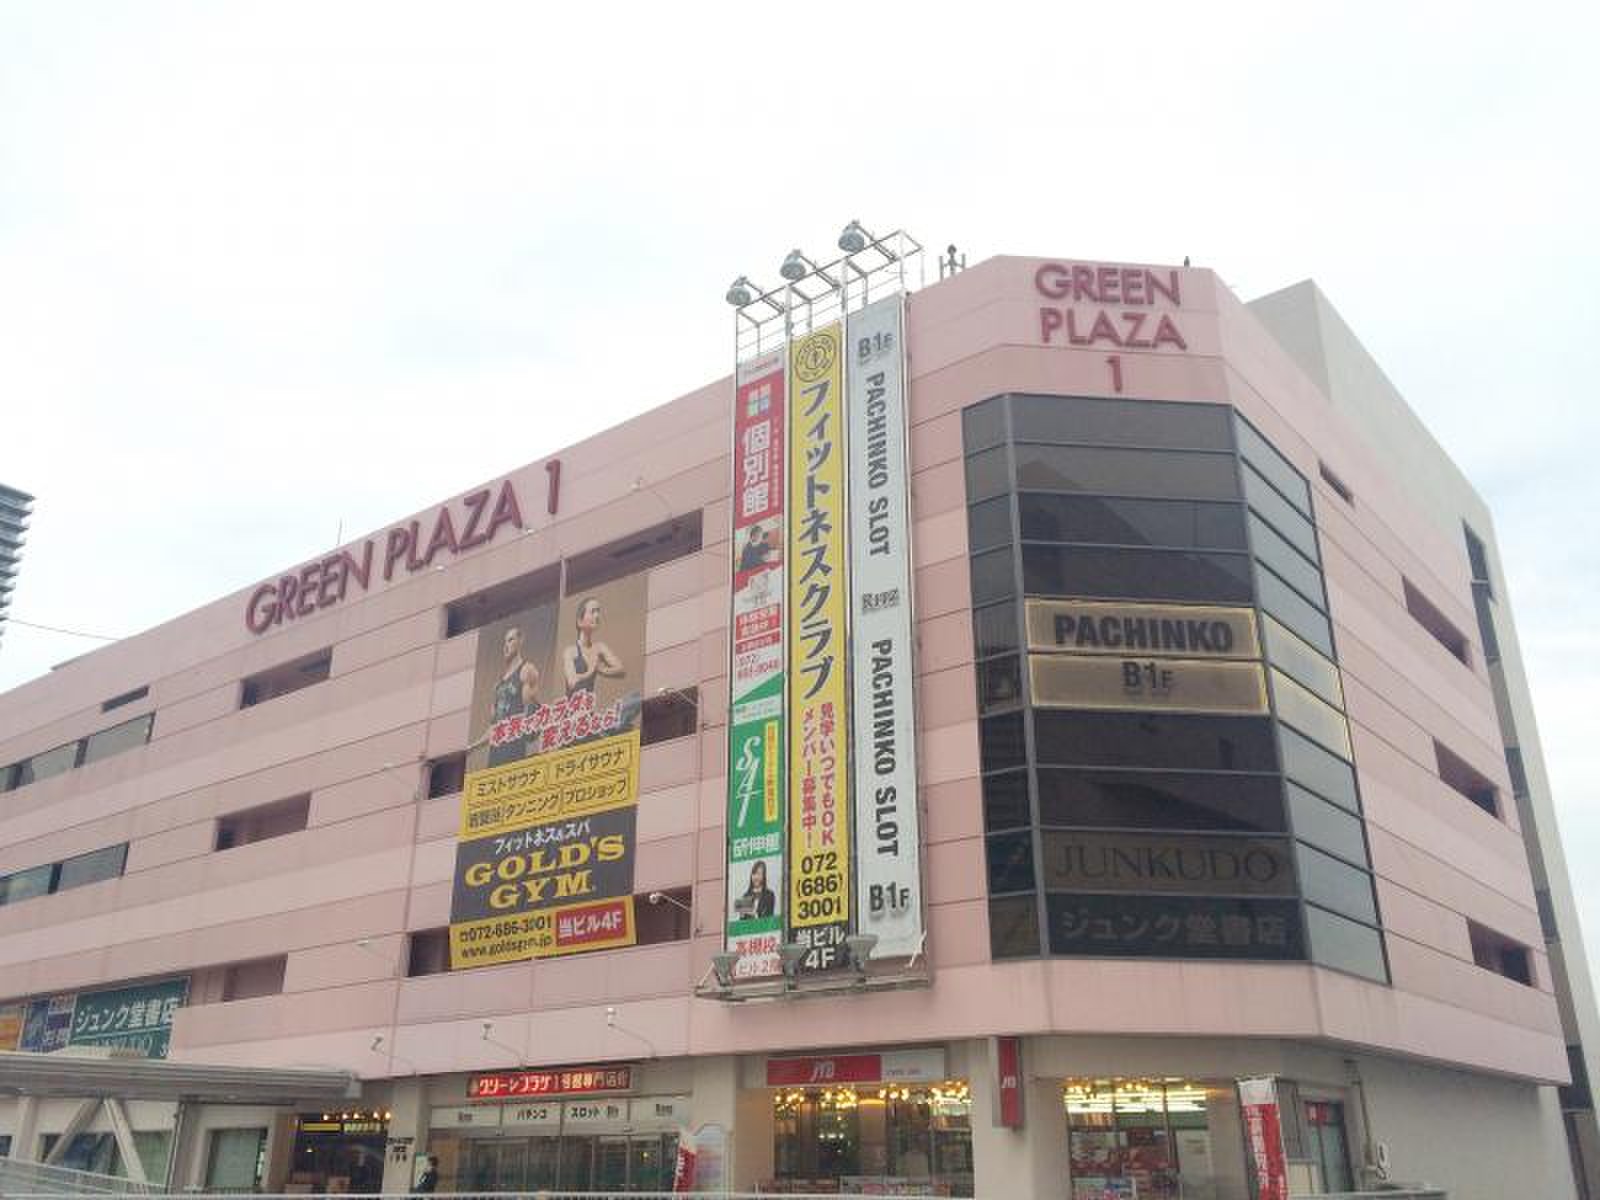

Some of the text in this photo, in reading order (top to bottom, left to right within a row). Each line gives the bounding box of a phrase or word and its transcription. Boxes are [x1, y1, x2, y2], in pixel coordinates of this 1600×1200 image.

[1035, 263, 1181, 306] GREEN
[857, 331, 894, 361] B1F
[1040, 307, 1187, 351] PLAZA
[1105, 355, 1123, 392] 1
[865, 371, 891, 556] PACHINKO SLOT
[245, 459, 561, 635] GREEN PLAZA 1
[799, 381, 834, 700] フィットネスクラブ
[1054, 614, 1233, 651] PACHINKO
[1122, 661, 1174, 690] B1F
[872, 638, 899, 857] PACHINKO SLOT
[476, 769, 542, 797] ミストサウナ
[464, 834, 625, 887] GOLD'S
[801, 852, 838, 875] 072
[1054, 845, 1279, 884] JUNKUDO
[489, 869, 596, 909] GYM
[796, 873, 843, 898] (686)
[869, 882, 910, 913] B1F
[559, 910, 623, 938] 当ビル4F
[797, 896, 841, 920] 3001
[1060, 908, 1288, 946] ジュンク堂書店
[804, 946, 836, 969] 4F
